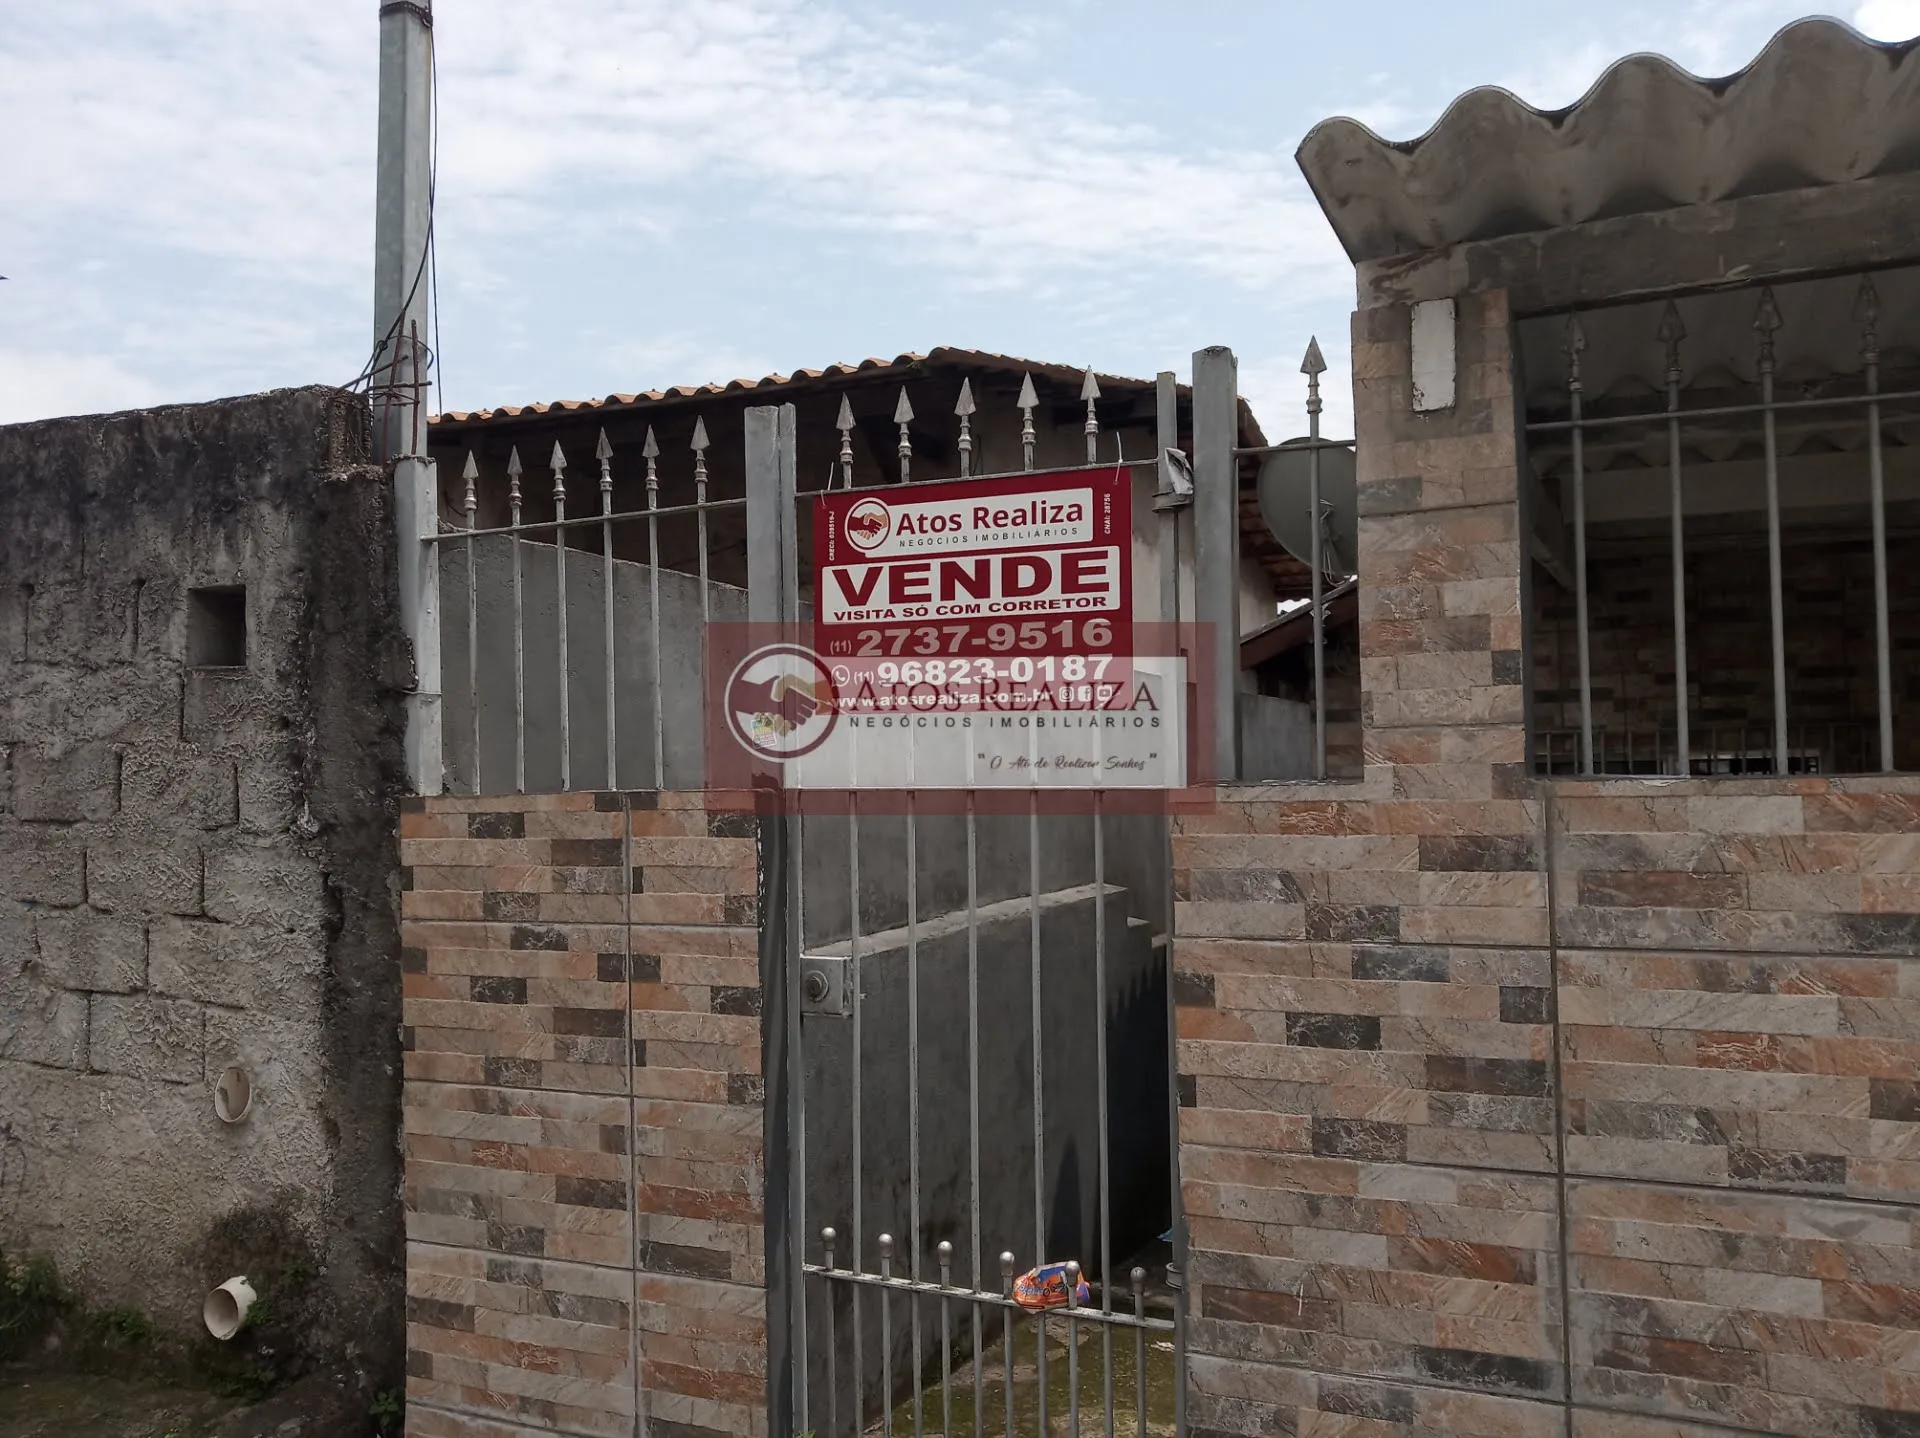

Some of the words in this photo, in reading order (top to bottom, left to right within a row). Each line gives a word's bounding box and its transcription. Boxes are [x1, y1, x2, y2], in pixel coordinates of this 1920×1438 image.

[896, 512, 963, 537] Atos
[972, 500, 1083, 530] Realiza
[832, 550, 1110, 607] VENDE
[834, 608, 896, 621] VISITA
[935, 604, 981, 616] COM
[988, 597, 1107, 613] CORRETOR
[830, 640, 852, 655] (11)
[857, 618, 1113, 657] 2737-9516
[853, 671, 875, 685] (11)
[877, 653, 1113, 687] 96823-0187
